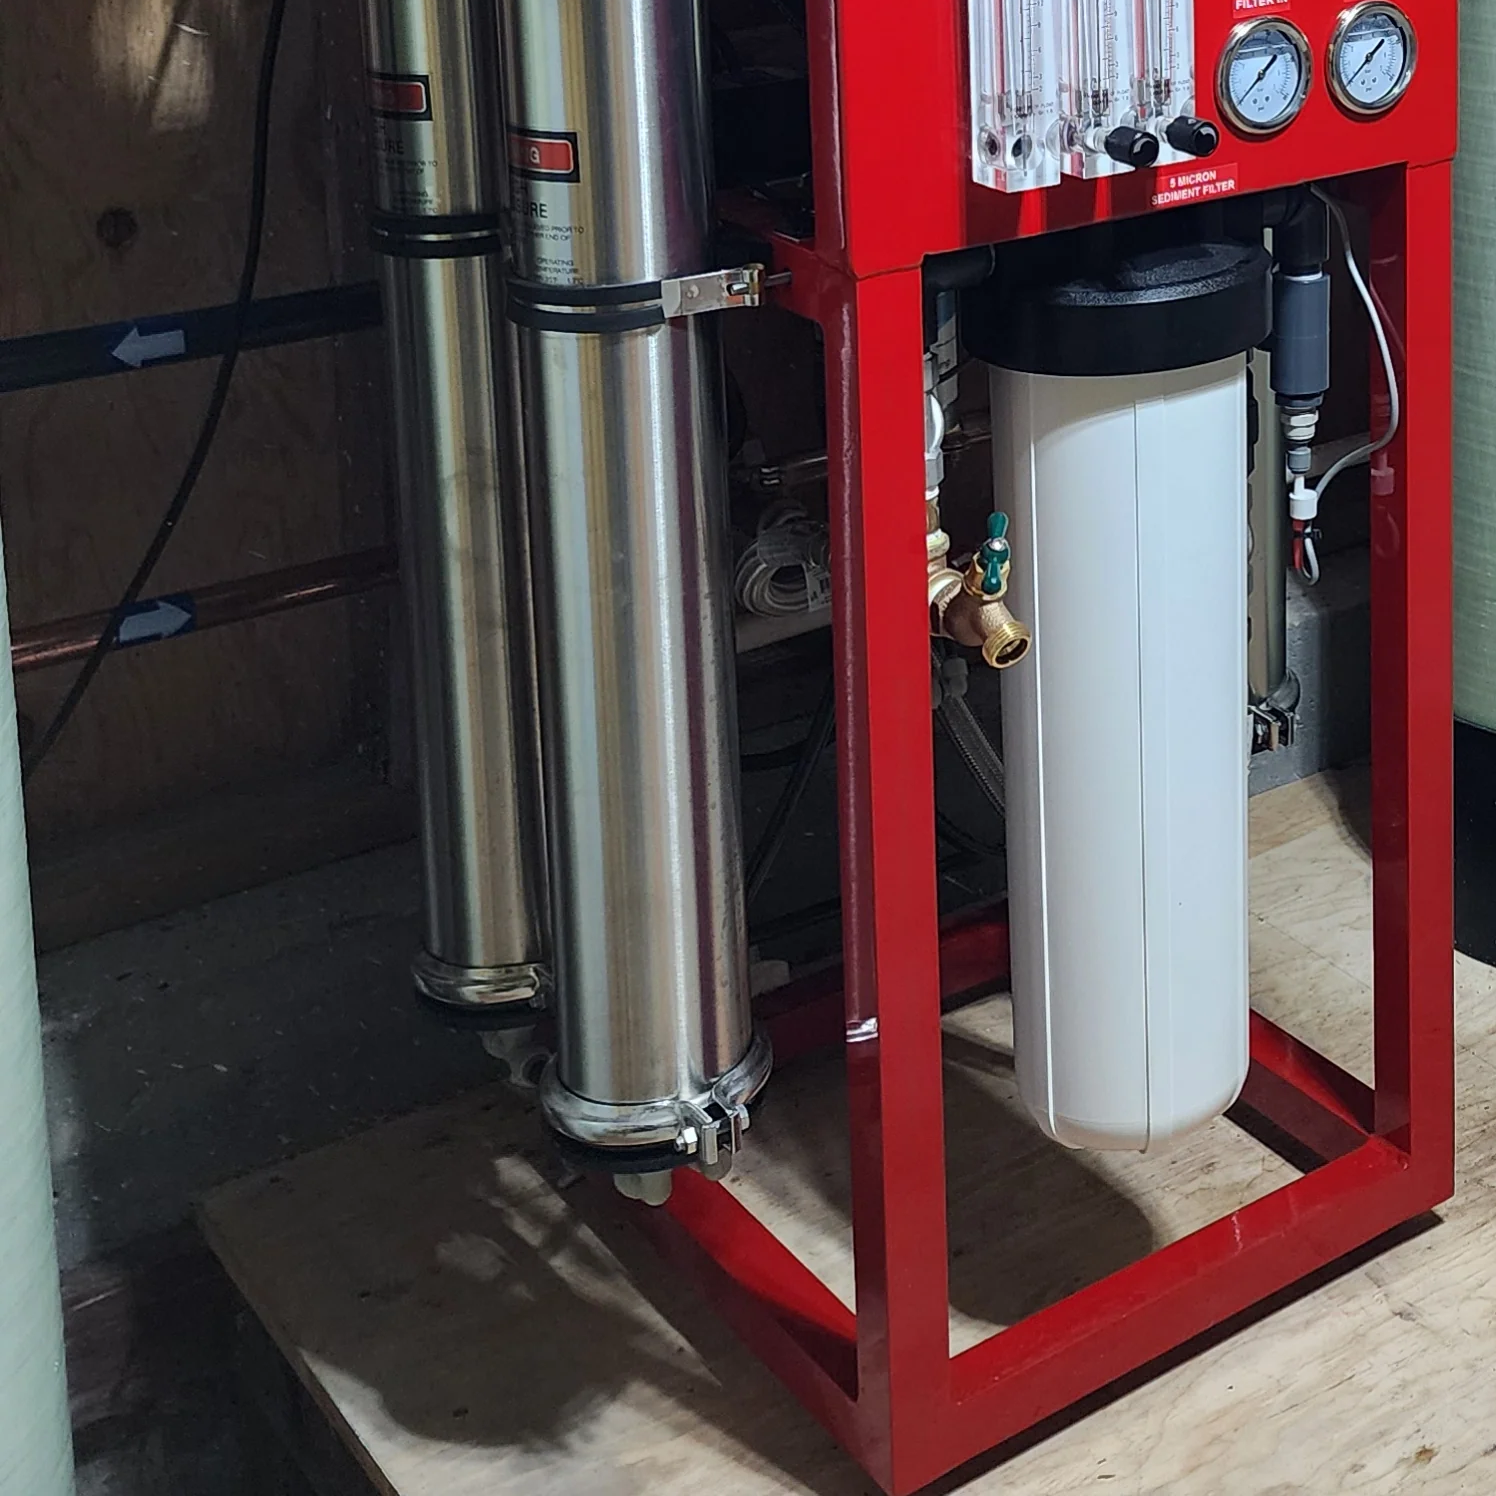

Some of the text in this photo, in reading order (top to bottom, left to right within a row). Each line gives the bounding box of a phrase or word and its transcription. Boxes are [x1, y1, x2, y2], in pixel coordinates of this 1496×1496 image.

[1169, 170, 1216, 188] 5 MICRON
[1151, 179, 1235, 205] SEDIMENT FILTER
